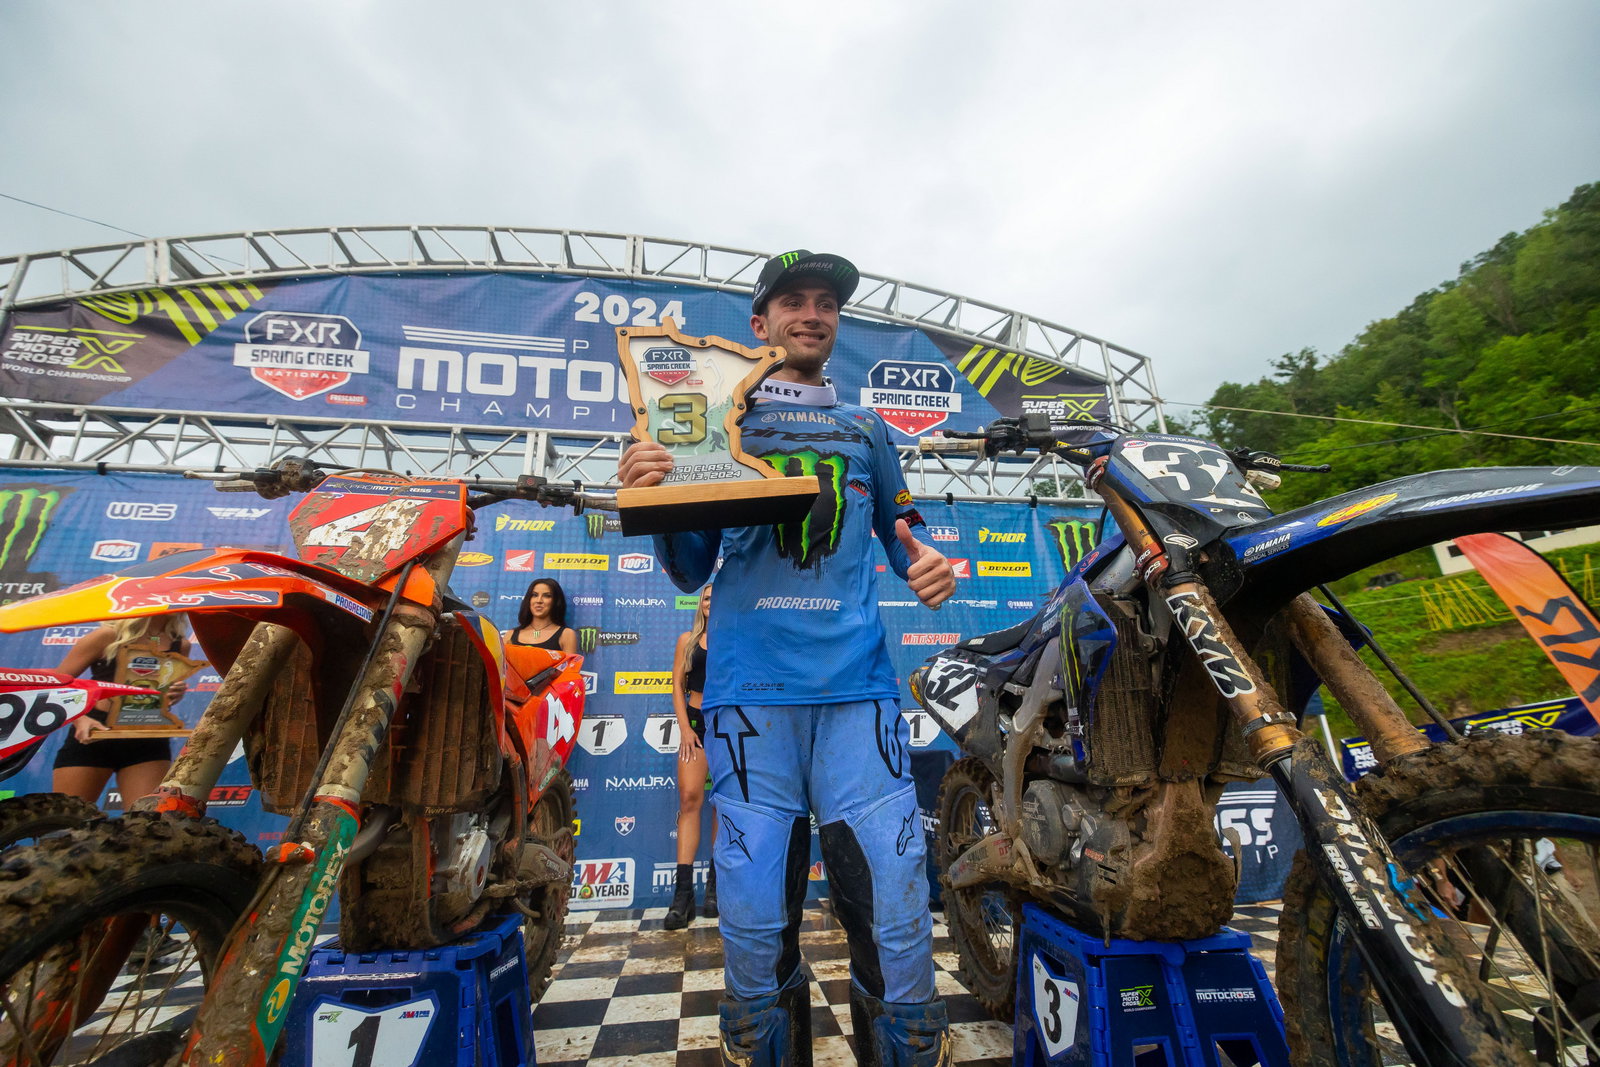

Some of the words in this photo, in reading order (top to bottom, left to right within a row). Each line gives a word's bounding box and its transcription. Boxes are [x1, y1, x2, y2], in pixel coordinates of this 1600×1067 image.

[574, 292, 686, 329] 2024
[10, 332, 81, 347] SUPER
[266, 319, 341, 345] FXR
[10, 342, 78, 356] MOTO
[652, 351, 683, 361] FXR
[2, 350, 77, 366] CROSS
[251, 348, 303, 366] SPRING
[307, 351, 354, 367] CREEK
[1, 363, 46, 375] WORLD
[46, 370, 132, 382] CHAMPIONSHIP
[264, 369, 339, 381] NATIONAL
[397, 346, 631, 405] MOTO
[883, 367, 940, 388] FXR
[872, 391, 911, 406] SPRING
[914, 394, 950, 408] CREEK
[657, 393, 708, 445] 3
[777, 412, 836, 426] YAMAHA
[883, 410, 939, 419] NATIONAL
[694, 463, 733, 472] CLASS
[710, 470, 742, 480] 2024
[1422, 483, 1544, 510] PROGRESSIVE
[107, 502, 177, 520] WPS
[509, 519, 555, 531] THOR
[987, 532, 1026, 542] THOR
[1254, 533, 1291, 553] YAMAHA
[98, 543, 136, 558] 100%
[622, 558, 650, 570] 100%
[335, 594, 374, 622] PROGRESSIVE
[615, 597, 666, 606] NAMURA
[755, 596, 841, 611] PROGRESSIVE
[0, 691, 67, 741] 96
[606, 775, 675, 788] NAMURA
[208, 787, 252, 800] ETS
[595, 885, 629, 897] YEARS
[281, 842, 350, 976] MOTOREX
[490, 959, 518, 980] MOTOCROSS
[1196, 991, 1256, 1000] MOTOCROSS
[399, 1011, 419, 1019] AMA
[1044, 978, 1062, 1044] 3
[347, 1016, 381, 1067] 1
